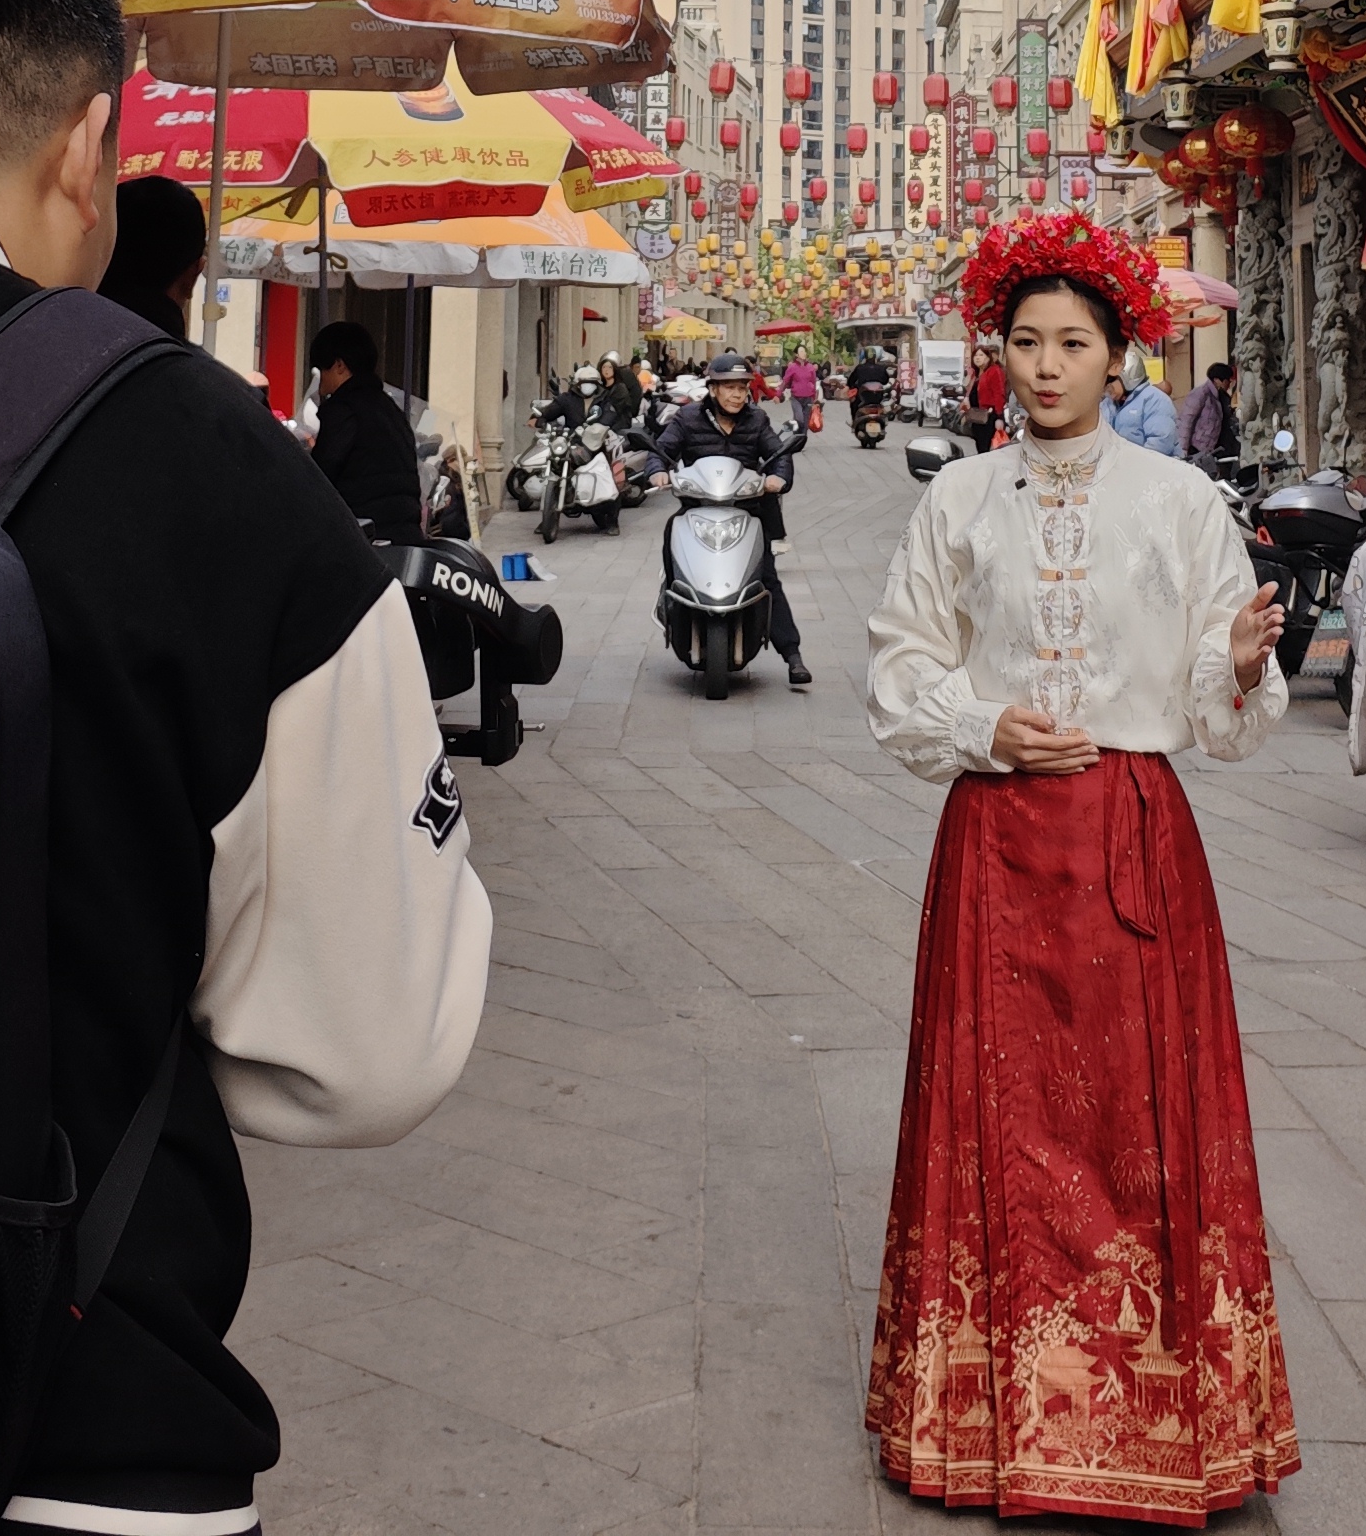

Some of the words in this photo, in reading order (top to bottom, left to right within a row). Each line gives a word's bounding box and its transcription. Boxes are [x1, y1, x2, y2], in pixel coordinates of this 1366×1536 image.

[363, 146, 529, 168] 人参健康饮品
[570, 253, 608, 278] 台湾
[432, 562, 504, 618] RONIN
